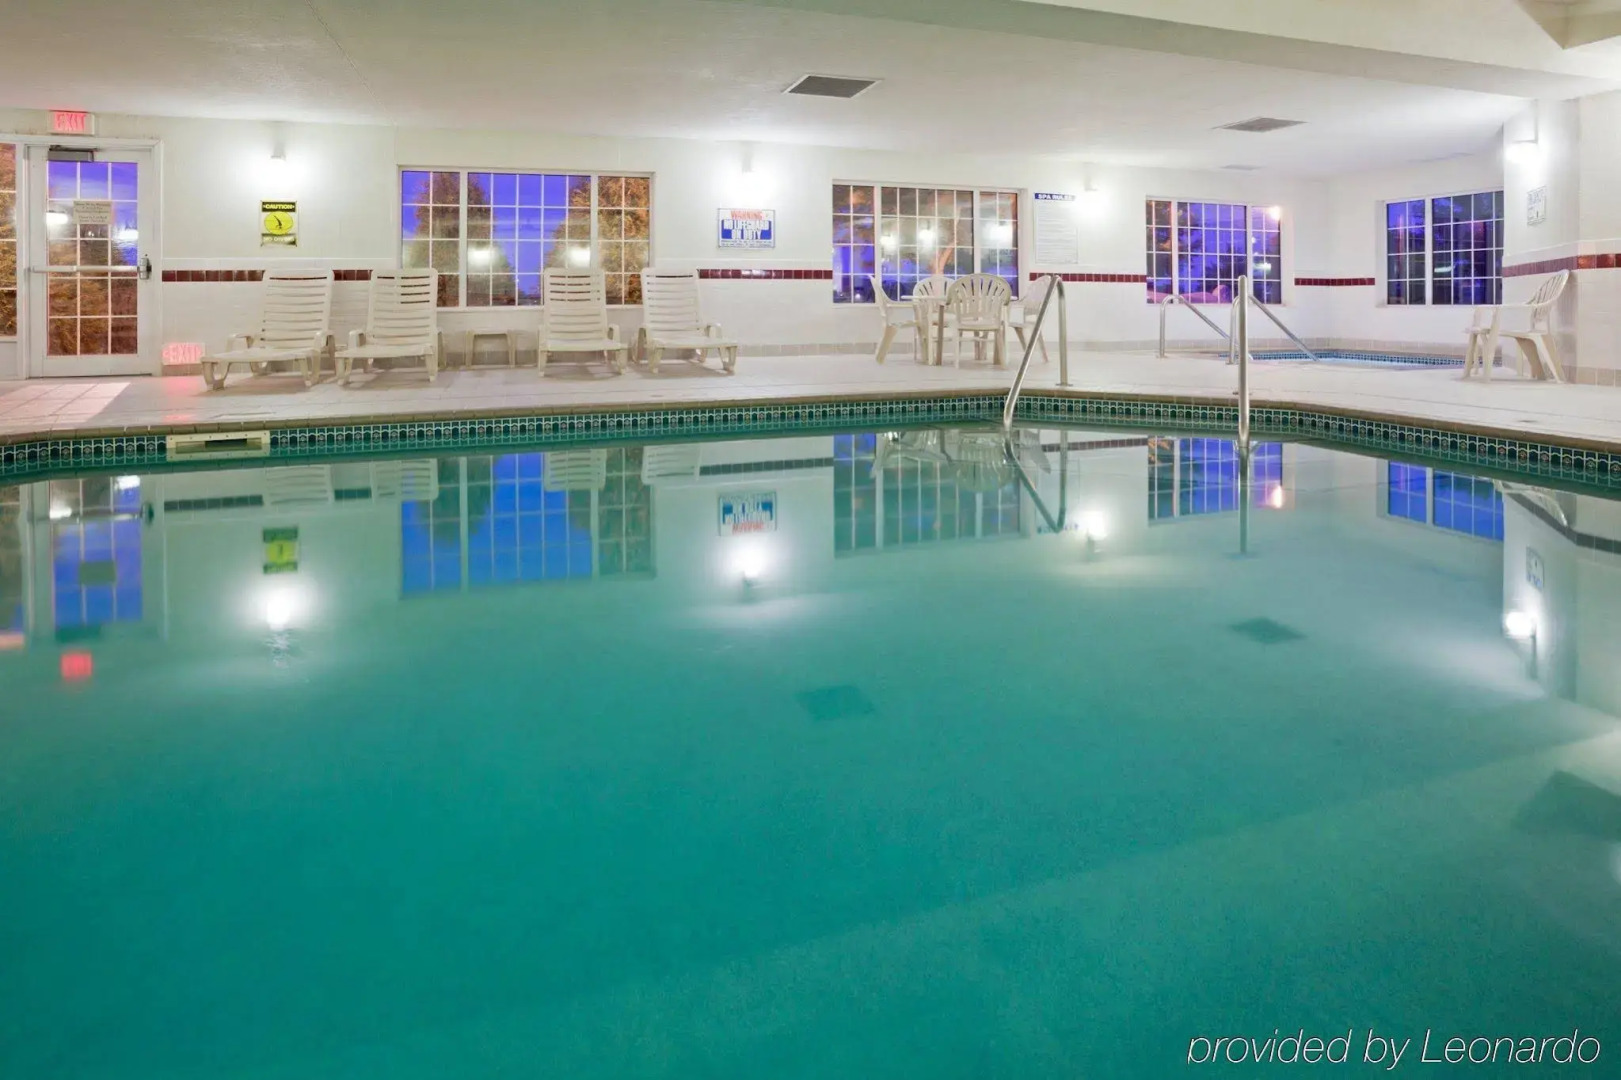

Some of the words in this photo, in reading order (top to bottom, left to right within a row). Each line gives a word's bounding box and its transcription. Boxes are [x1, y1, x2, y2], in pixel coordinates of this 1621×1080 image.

[55, 112, 86, 130] EXIT
[1038, 192, 1051, 200] SPA
[723, 219, 733, 230] NO
[731, 229, 742, 240] ON
[743, 229, 762, 240] DUTY
